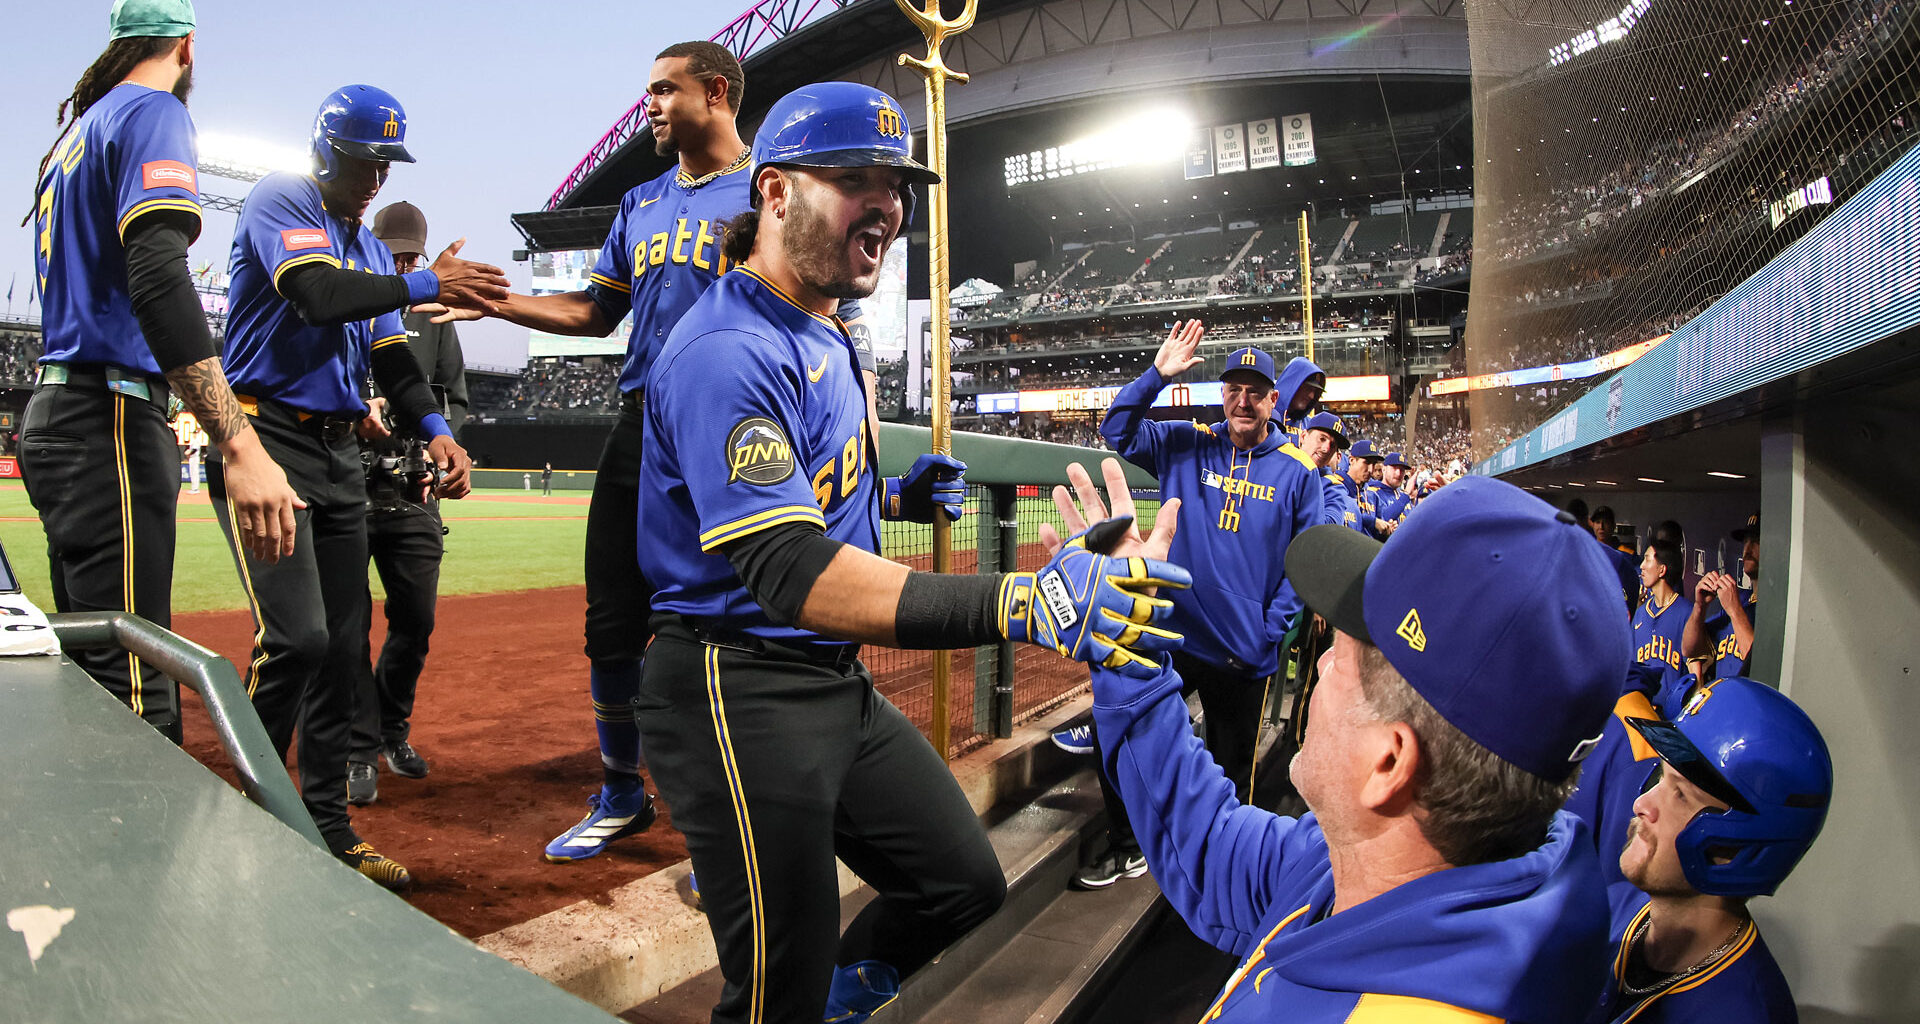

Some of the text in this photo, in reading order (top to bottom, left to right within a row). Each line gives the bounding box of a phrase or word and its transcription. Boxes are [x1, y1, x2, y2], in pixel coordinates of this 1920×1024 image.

[1256, 136, 1270, 146] 1997
[1291, 131, 1305, 141] 2001
[1262, 146, 1275, 154] WEST
[1297, 141, 1310, 149] WEST
[1229, 150, 1241, 159] WEST
[1286, 150, 1314, 160] CHAMPIONS
[1218, 160, 1245, 169] CHAMPIONS
[1251, 155, 1279, 165] CHAMPIONS
[1806, 176, 1833, 206] CLUB
[1057, 392, 1088, 411] HOME
[730, 441, 792, 482] PNW
[1223, 476, 1276, 503] SEATTLE
[1637, 635, 1681, 671] eattle
